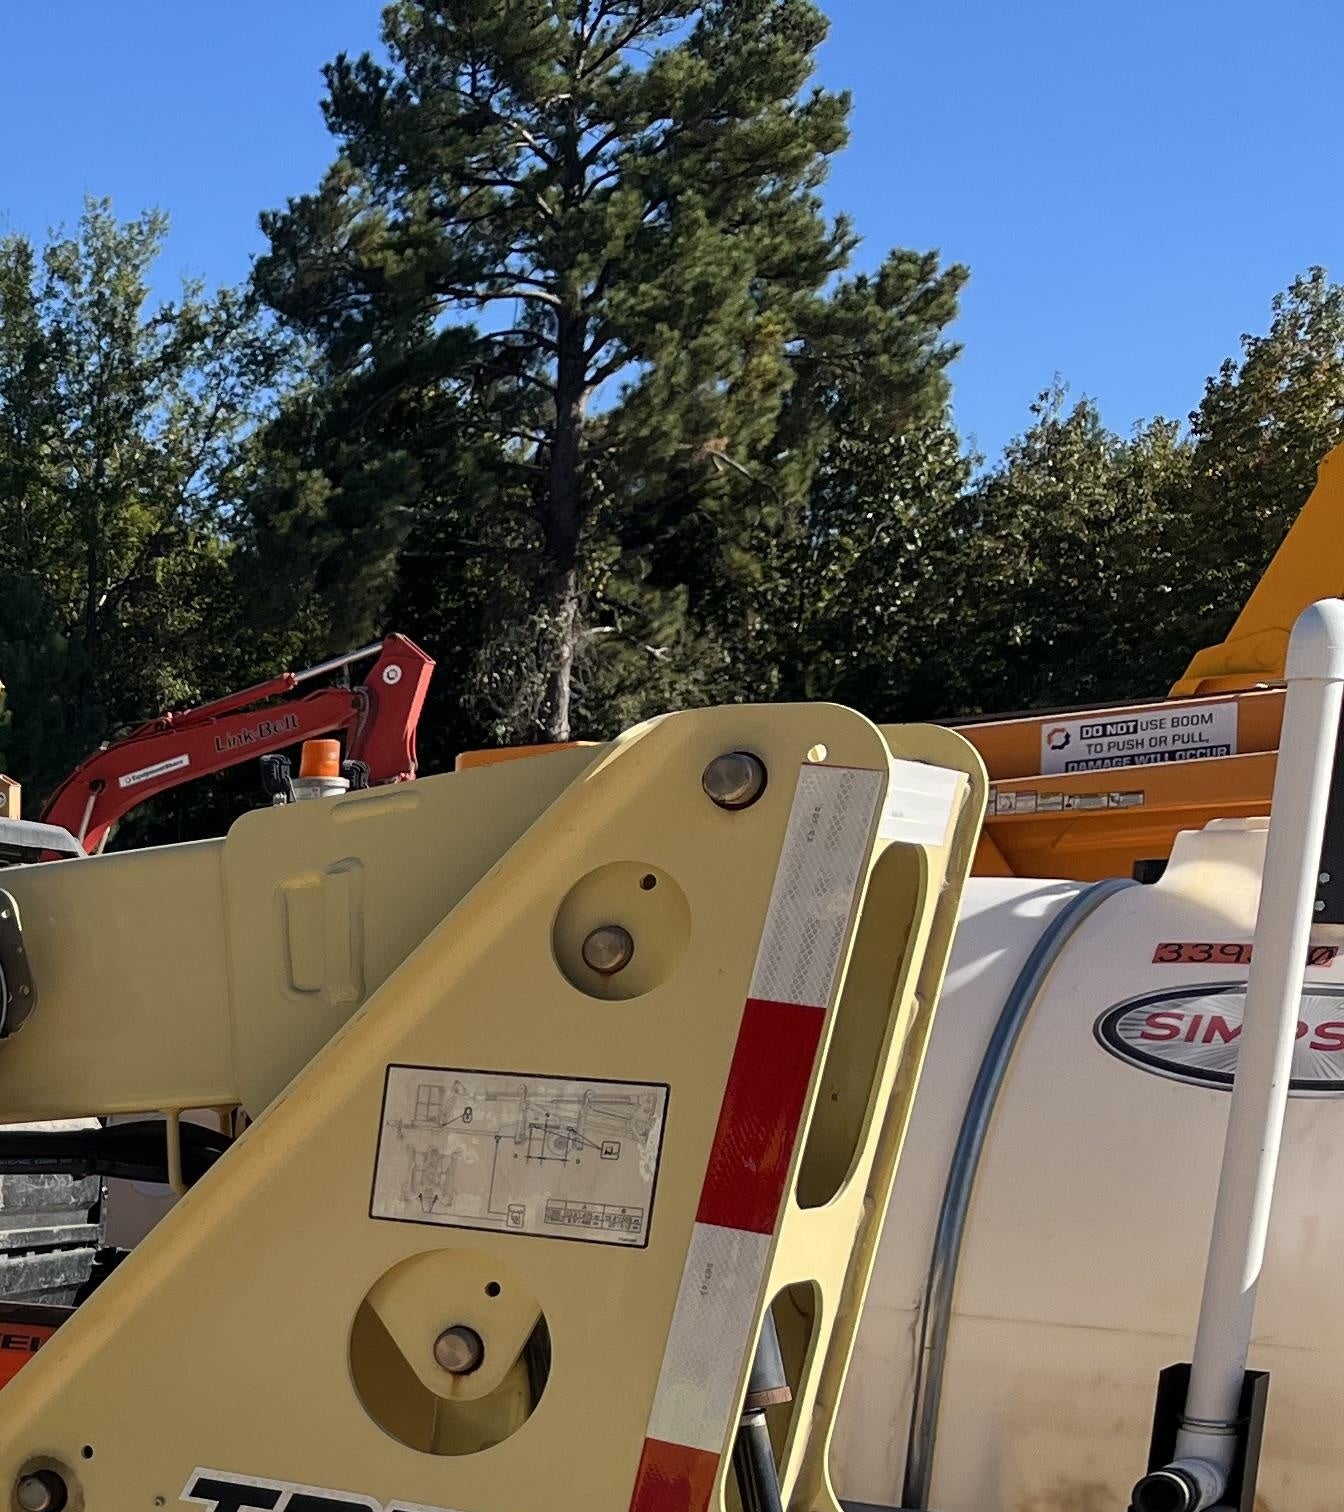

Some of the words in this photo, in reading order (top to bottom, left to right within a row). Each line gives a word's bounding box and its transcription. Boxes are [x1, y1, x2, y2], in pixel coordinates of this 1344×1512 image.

[1082, 726, 1103, 739] DO
[1106, 721, 1137, 735] NOT
[1140, 718, 1167, 732] USE
[1171, 713, 1213, 729] BOOM
[1086, 743, 1104, 756] TO
[1107, 737, 1145, 753] PUSH
[1148, 735, 1168, 748] OR
[1172, 731, 1209, 747] PULL,
[1175, 746, 1228, 762] OCCUR
